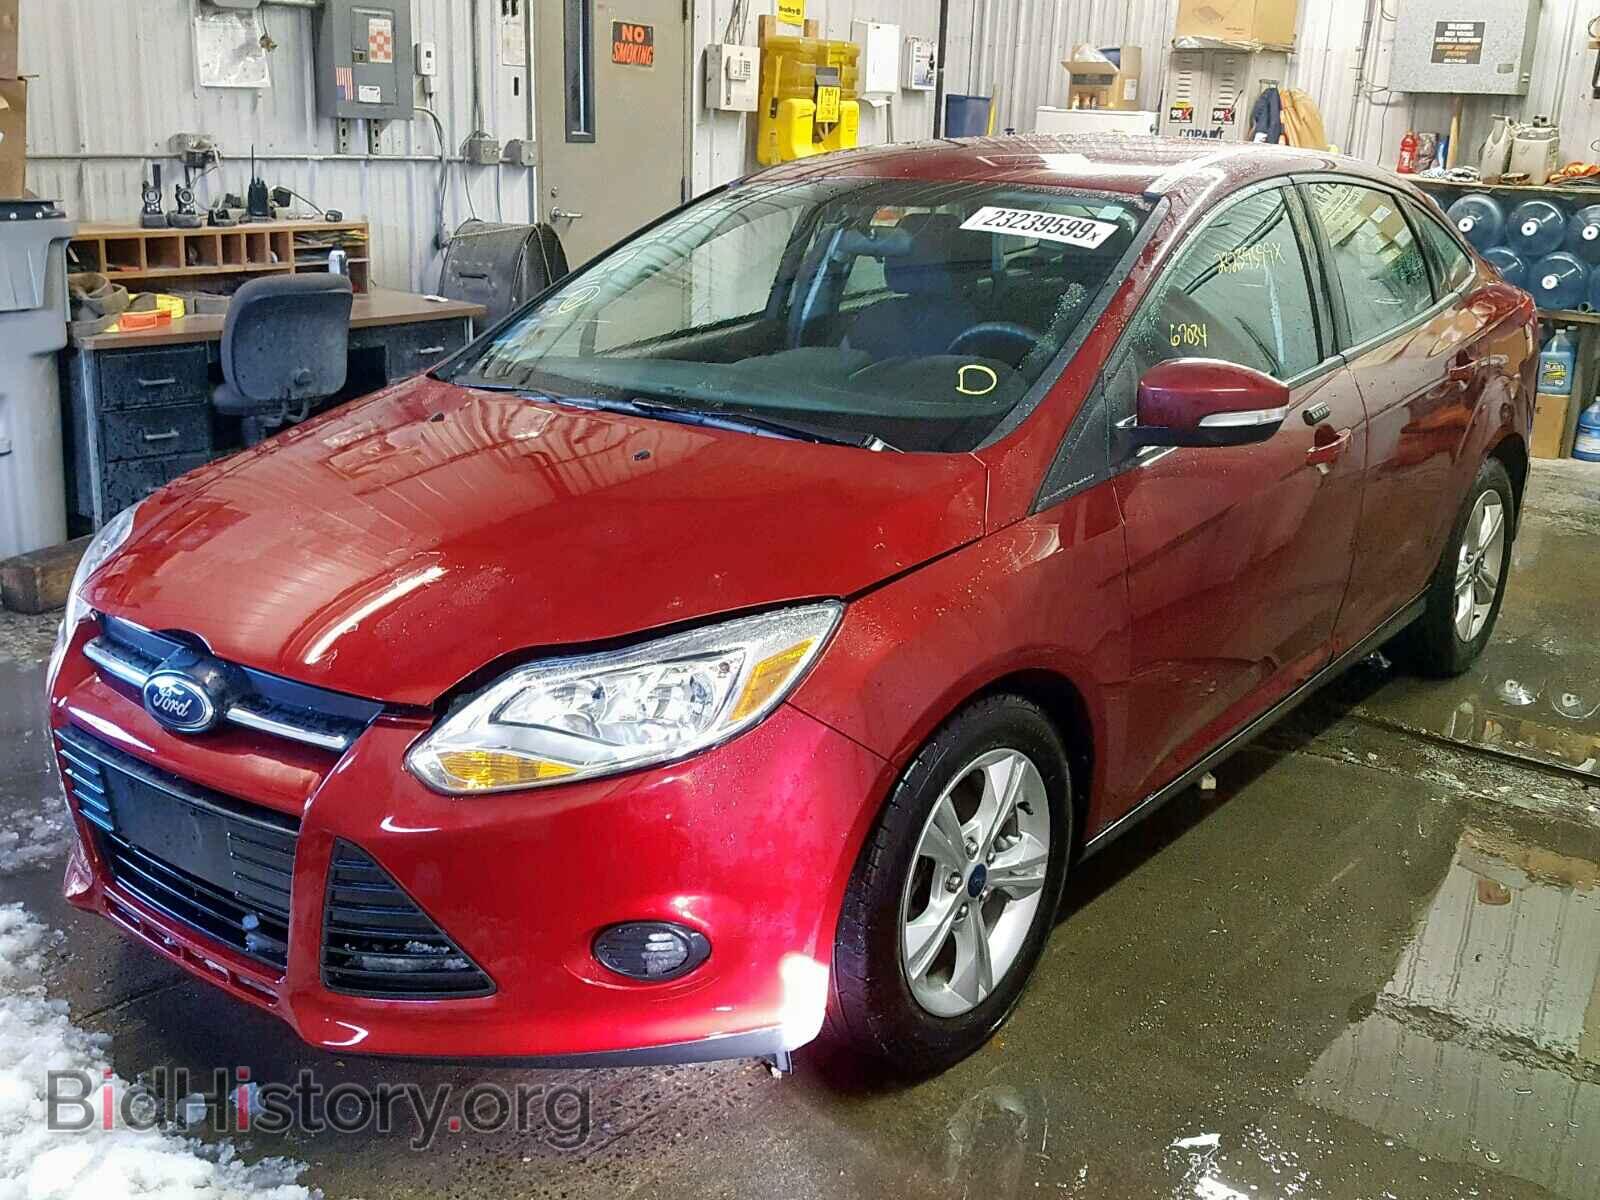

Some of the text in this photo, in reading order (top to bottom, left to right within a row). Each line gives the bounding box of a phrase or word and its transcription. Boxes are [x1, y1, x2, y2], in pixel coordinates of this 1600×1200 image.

[622, 24, 645, 43] NO
[613, 41, 653, 65] SMOKING
[153, 682, 193, 717] Ford
